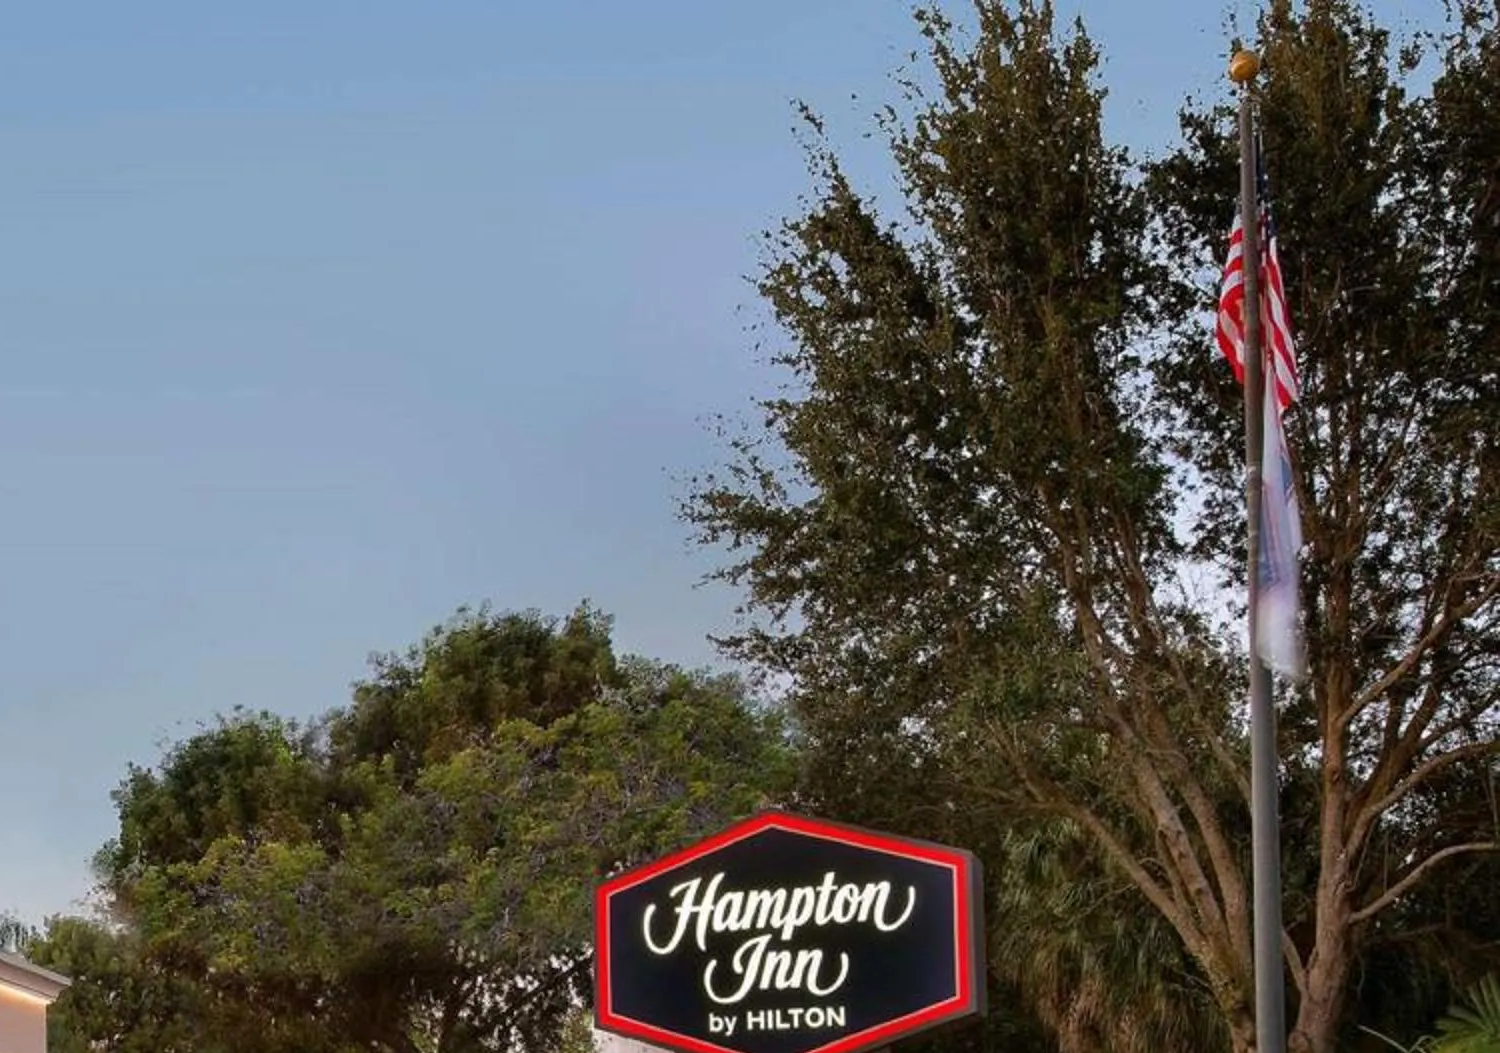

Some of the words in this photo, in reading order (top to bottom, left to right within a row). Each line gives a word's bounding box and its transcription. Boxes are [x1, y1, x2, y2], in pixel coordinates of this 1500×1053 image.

[643, 871, 916, 955] Hampton
[704, 934, 849, 1004] Inn
[708, 1012, 737, 1037] by
[747, 1006, 847, 1031] HILTON
